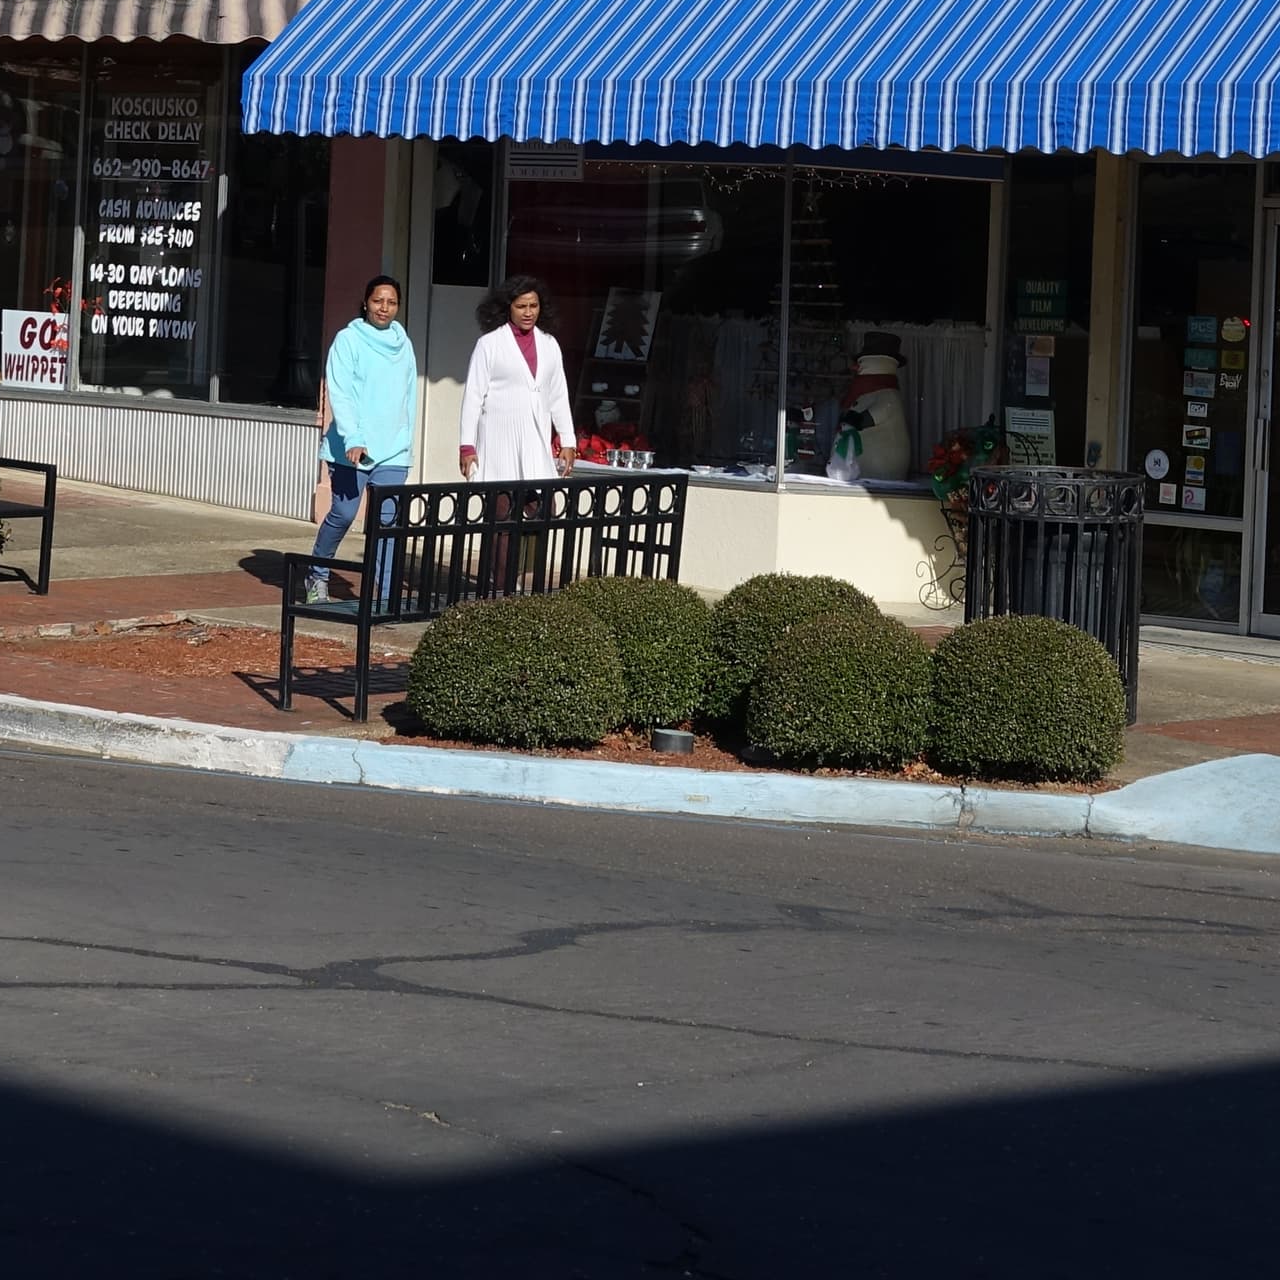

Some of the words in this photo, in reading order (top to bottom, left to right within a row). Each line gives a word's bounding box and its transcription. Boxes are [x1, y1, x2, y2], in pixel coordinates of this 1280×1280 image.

[111, 96, 198, 117] KOSCIUSKO
[104, 120, 151, 141] CHECK
[158, 121, 203, 142] DELAY
[92, 157, 210, 179] 662-290-8647
[98, 199, 130, 219] CASH
[136, 199, 202, 222] ADVANCES
[99, 223, 135, 245] FROM
[140, 224, 195, 249] $25-$410
[89, 263, 125, 284] 14-30
[130, 265, 156, 286] DAY
[161, 266, 203, 289] LOANS
[108, 289, 182, 314] DEPENDING
[19, 316, 57, 351] GO
[91, 314, 108, 336] ON
[112, 315, 145, 338] YOUR
[149, 316, 197, 341] PAYDAY
[4, 352, 68, 385] WHIPPET
